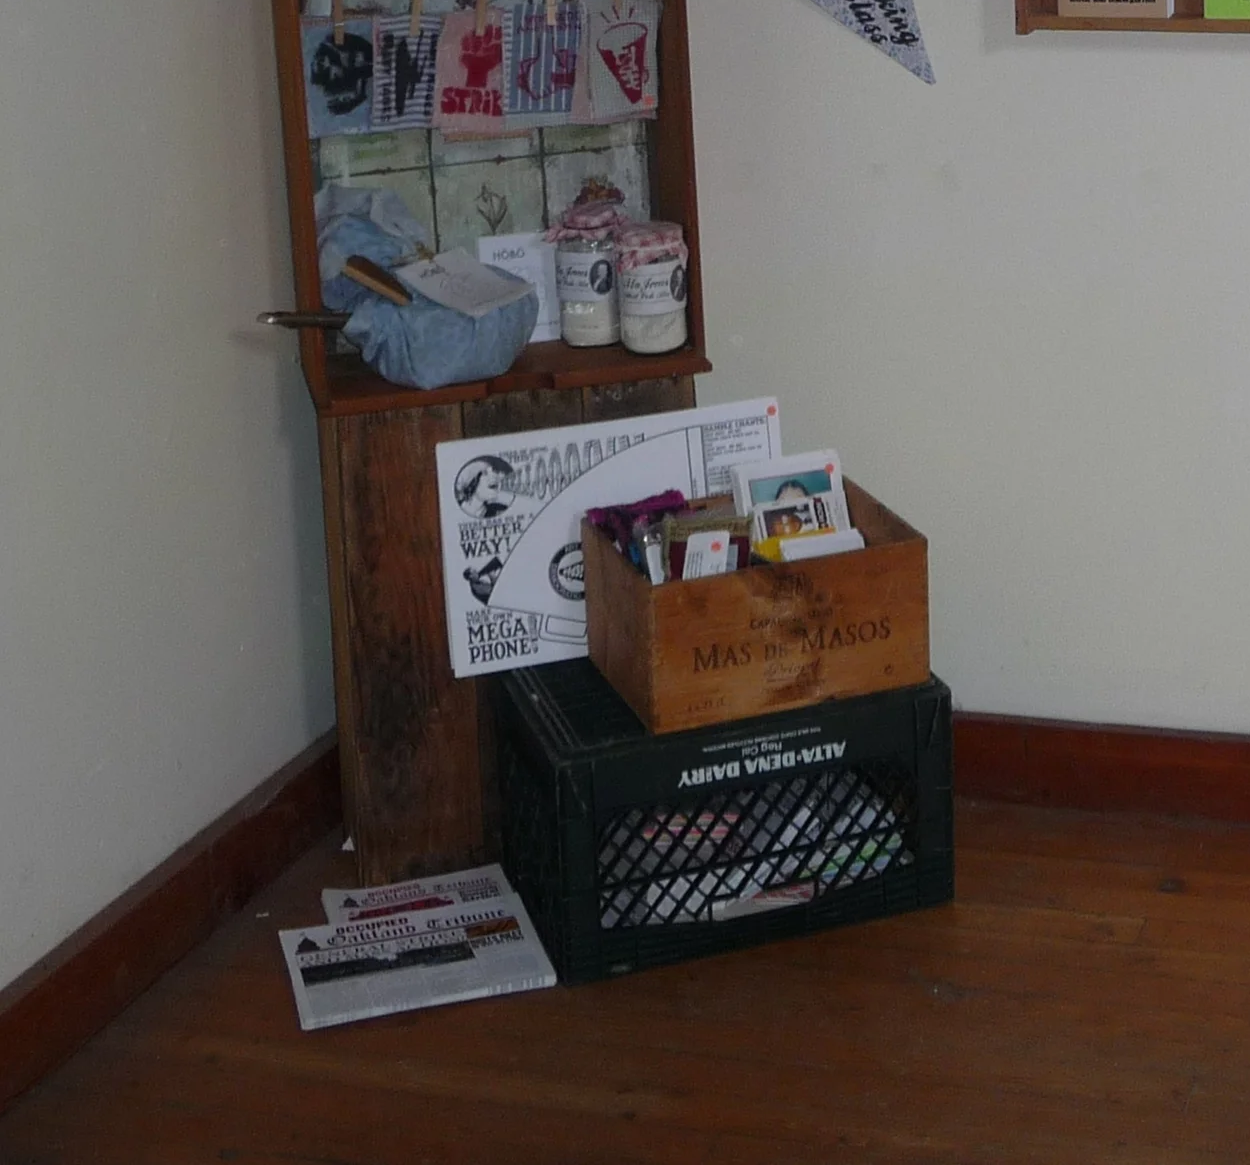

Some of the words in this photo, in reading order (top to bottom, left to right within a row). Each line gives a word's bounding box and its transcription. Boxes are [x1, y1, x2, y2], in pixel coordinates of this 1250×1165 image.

[460, 522, 523, 541] BETTER
[460, 536, 511, 558] WAY!
[467, 618, 529, 646] MEGA
[692, 642, 752, 675] MAS
[801, 616, 892, 654] MASOS
[742, 745, 759, 756] Cal
[761, 741, 783, 753] Reg
[678, 760, 741, 789] DAIRY
[336, 917, 408, 935] OCCUPIED
[427, 910, 504, 930] Tribune
